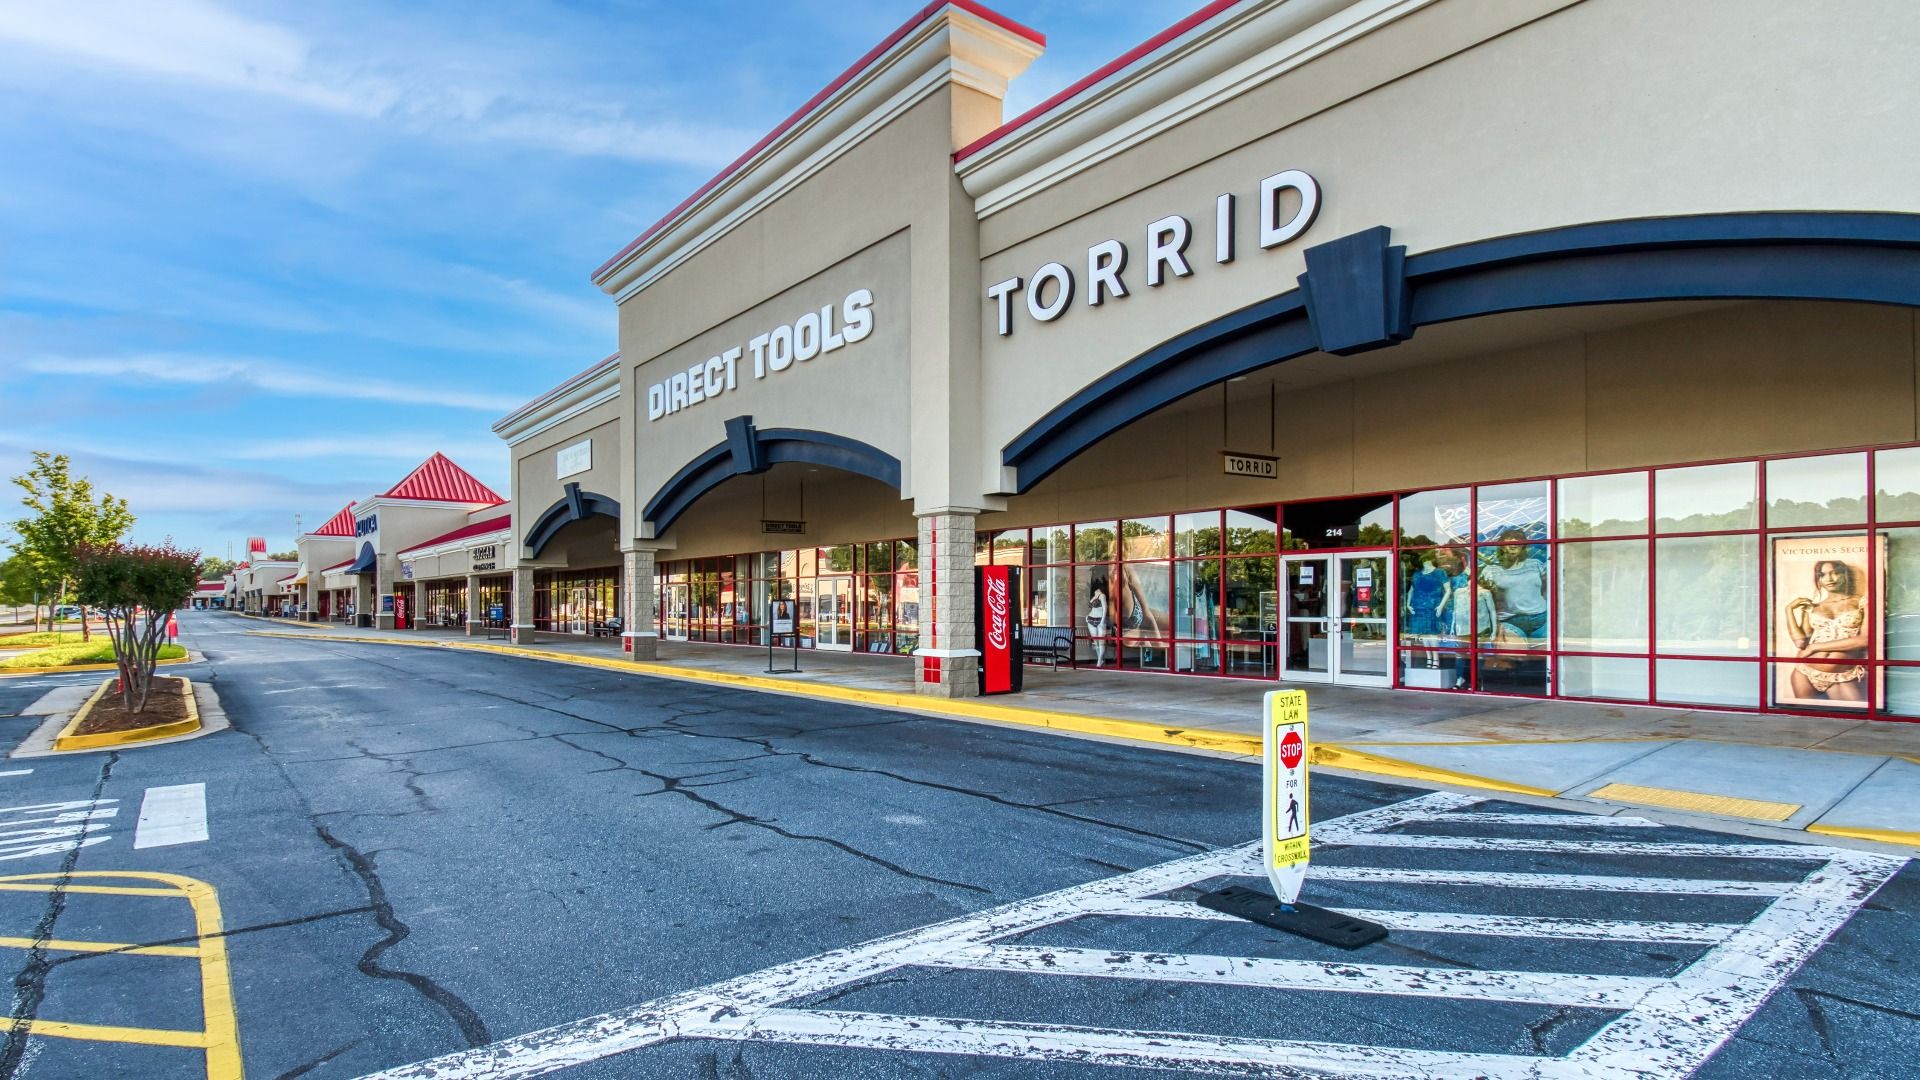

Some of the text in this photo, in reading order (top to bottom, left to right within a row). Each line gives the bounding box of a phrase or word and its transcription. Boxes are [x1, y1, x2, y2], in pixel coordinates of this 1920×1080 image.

[988, 169, 1322, 336] TORRID
[648, 288, 874, 421] DIRECT TOOLS
[1230, 459, 1272, 474] TORRID
[1326, 528, 1343, 537] 214
[1280, 695, 1302, 708] STATE
[1284, 710, 1299, 720] LAW
[1281, 743, 1302, 758] STOP
[1286, 779, 1298, 788] FOR
[1277, 850, 1307, 863] CROSSWALK
